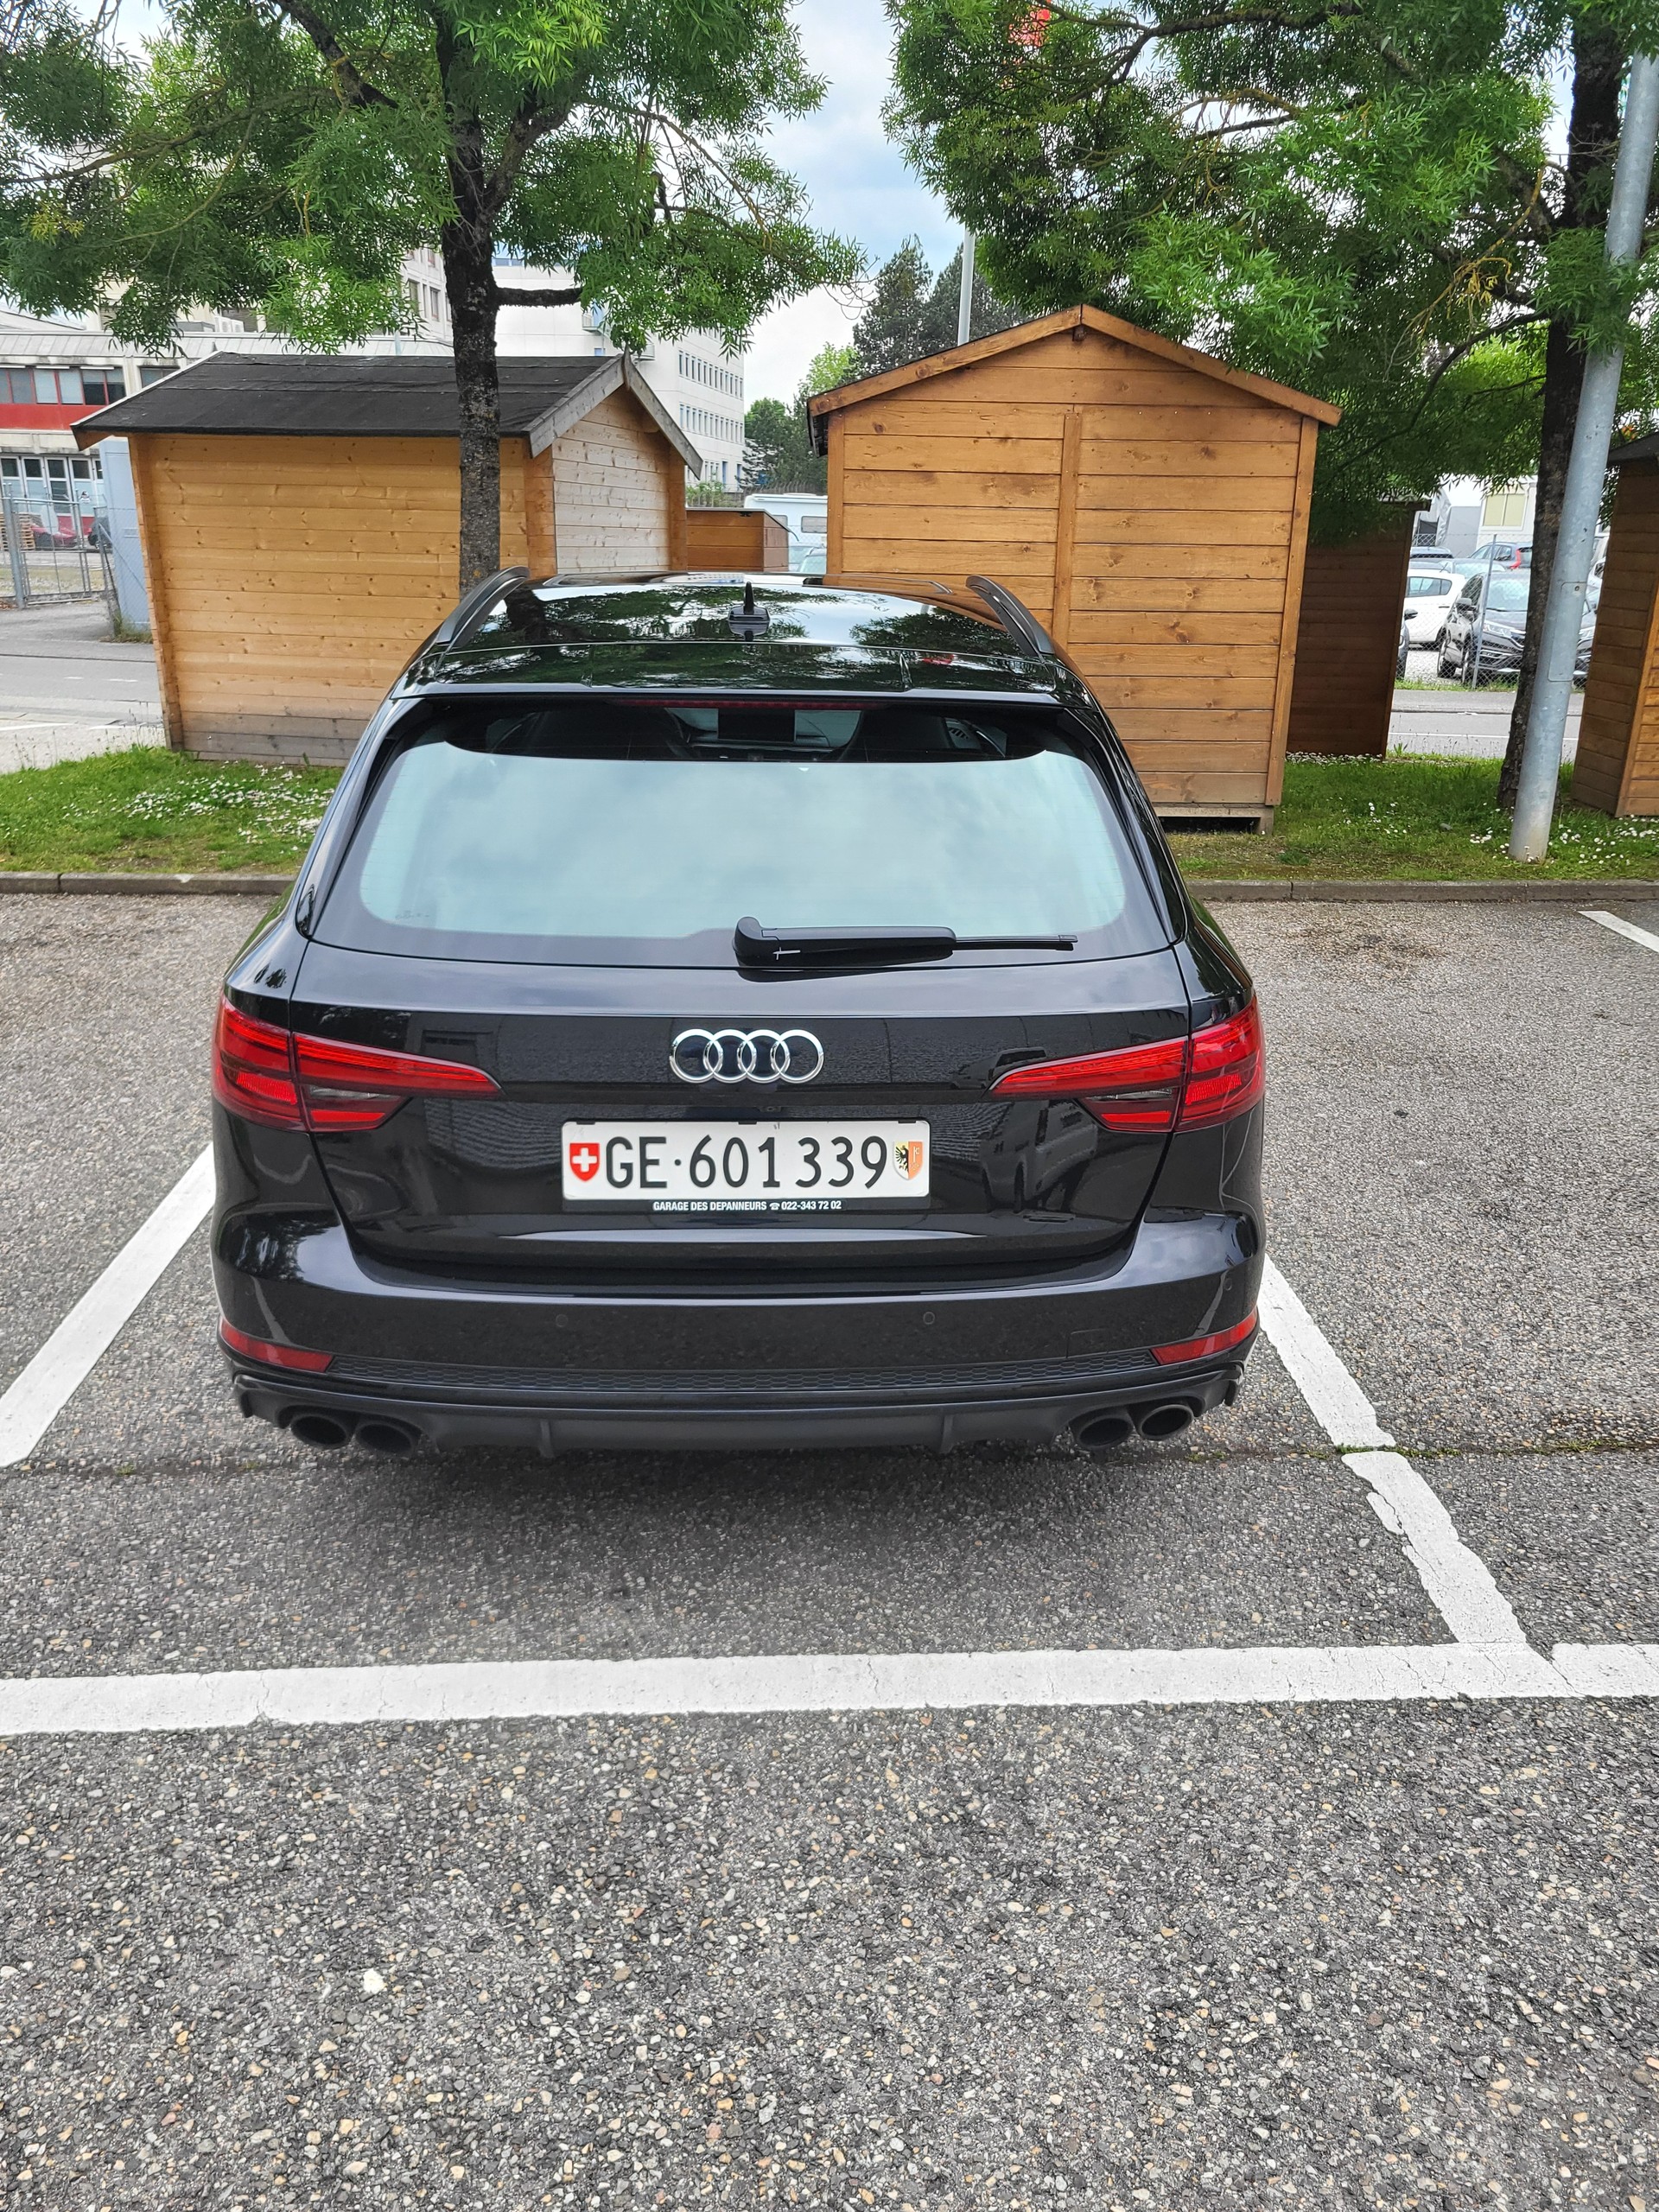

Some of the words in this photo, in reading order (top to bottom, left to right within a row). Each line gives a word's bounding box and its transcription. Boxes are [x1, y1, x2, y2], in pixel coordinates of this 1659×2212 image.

[653, 1201, 690, 1211] GARAGE
[690, 1201, 709, 1211] DES
[709, 1201, 767, 1211] DEPANNEURS
[781, 1200, 817, 1211] 022-343
[817, 1200, 830, 1210] 72
[830, 1200, 842, 1210] 02
